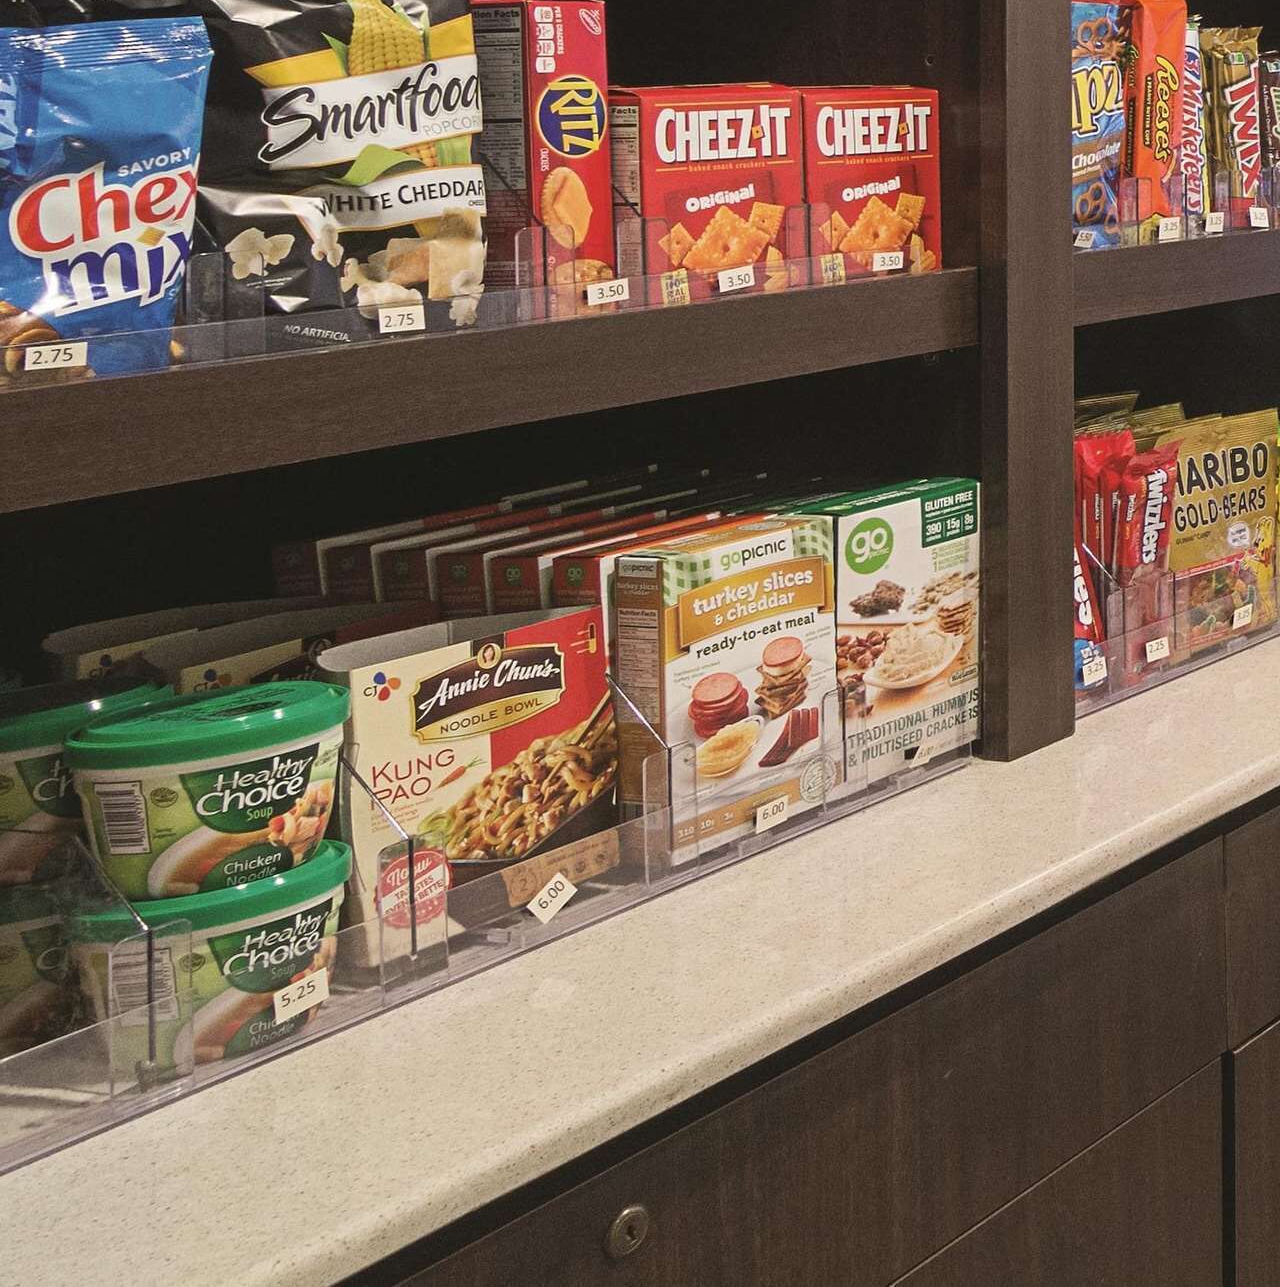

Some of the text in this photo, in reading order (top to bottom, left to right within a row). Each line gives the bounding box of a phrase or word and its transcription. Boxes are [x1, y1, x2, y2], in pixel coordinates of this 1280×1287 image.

[258, 63, 479, 163] Smartfood
[548, 81, 600, 152] RITZ
[1228, 65, 1262, 196] TWIX
[117, 148, 191, 177] SAVORY
[1072, 140, 1121, 168] Chocolate
[16, 168, 199, 254] Chex
[1163, 219, 1178, 231] 3.25
[51, 228, 192, 312] mix
[879, 255, 901, 267] 3.50
[597, 285, 625, 299] 3.50
[727, 273, 751, 289] 3.50
[284, 325, 302, 335] NO
[385, 314, 415, 329] 2.75
[32, 348, 74, 366] 2.75
[924, 490, 973, 512] GLUTEN FREE
[1142, 468, 1168, 565] Twizzlers
[926, 521, 942, 536] 390
[720, 539, 787, 571] gopicnic
[849, 527, 890, 563] go
[692, 569, 814, 616] turkey slices
[714, 590, 796, 626] & cheddar
[696, 612, 816, 659] ready-to-eat meal
[1149, 640, 1165, 653] 2.25
[1087, 657, 1104, 675] 3.25
[363, 685, 378, 698] CJ
[416, 658, 561, 722] Annie Chun's
[440, 695, 543, 735] NOODLE BOWL
[848, 708, 929, 749] TRADITIONAL
[849, 753, 858, 767] &
[861, 728, 923, 764] MULTISEED
[214, 755, 315, 791] Healthy
[371, 747, 455, 788] KUNG
[196, 776, 304, 816] Choice
[370, 776, 432, 811] PAO
[246, 804, 274, 821] Soup
[762, 801, 785, 820] 6.00
[224, 851, 282, 875] Chicken
[226, 865, 280, 887] Noodle
[537, 880, 566, 910] 6.00
[242, 907, 331, 951] Healthy
[223, 932, 321, 977] Choice
[281, 979, 316, 1007] 5.25
